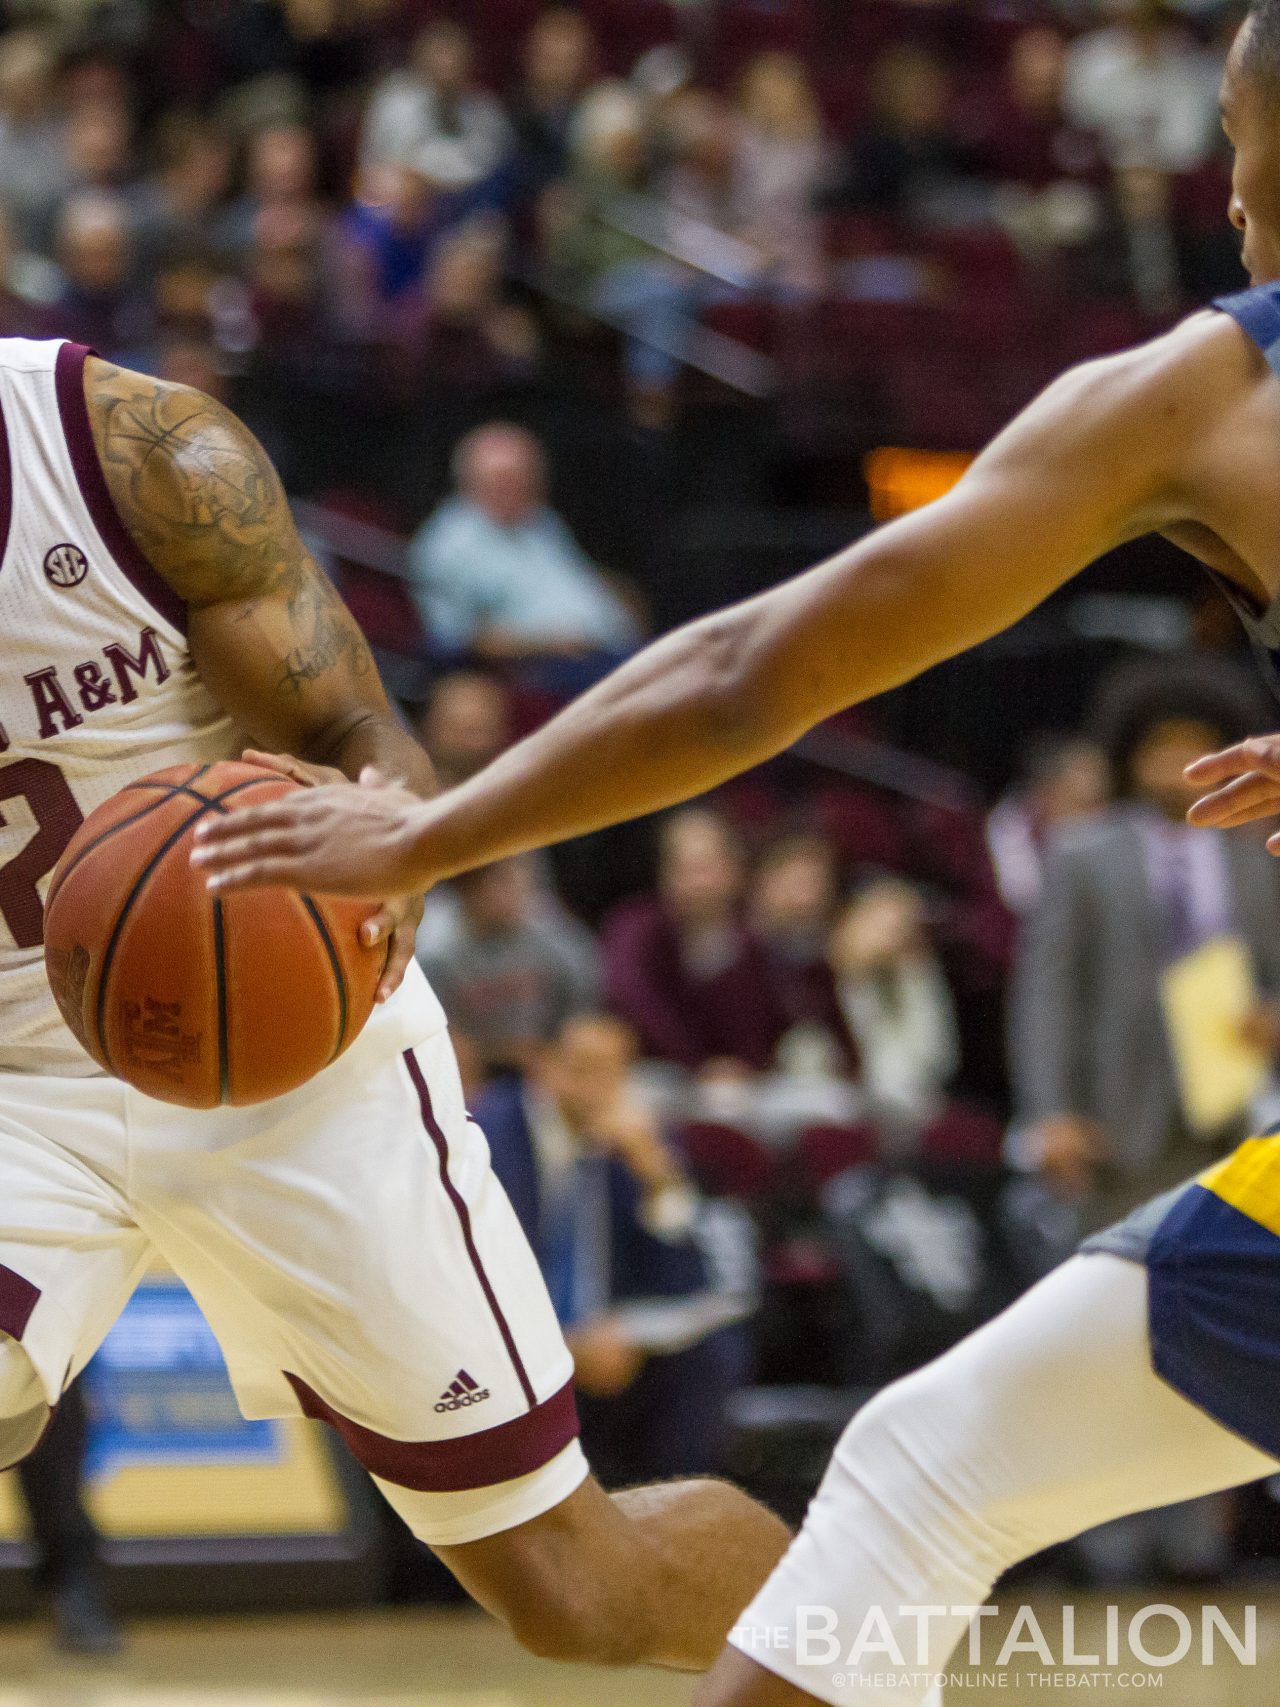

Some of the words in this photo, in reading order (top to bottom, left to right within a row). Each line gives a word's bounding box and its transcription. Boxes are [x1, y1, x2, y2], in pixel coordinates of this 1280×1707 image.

[46, 546, 87, 586] SEC
[24, 626, 171, 740] A&M
[434, 1388, 490, 1413] adidas
